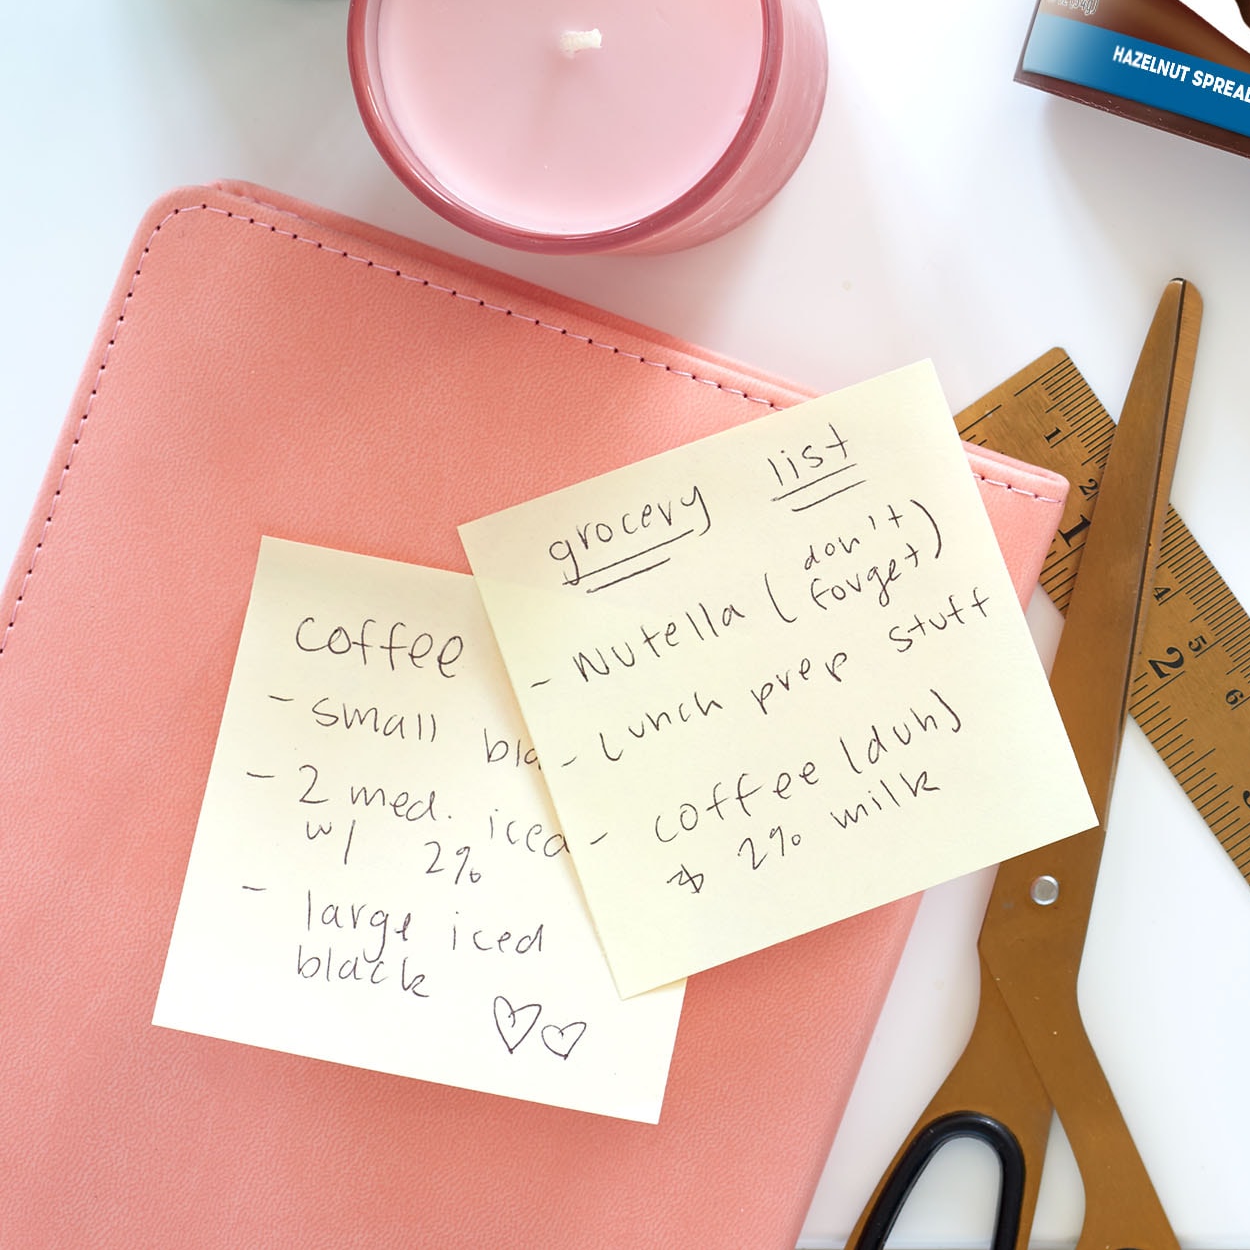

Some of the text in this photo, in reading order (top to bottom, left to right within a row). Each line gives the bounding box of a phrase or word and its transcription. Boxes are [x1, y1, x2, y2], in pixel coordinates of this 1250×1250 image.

[1112, 44, 1191, 84] HAZELNUT
[1044, 427, 1061, 443] 1
[549, 422, 850, 586] grocery list
[1079, 478, 1099, 496] 2
[1058, 514, 1092, 547] 1
[1153, 584, 1172, 603] 4
[750, 651, 849, 715] prep
[888, 586, 991, 653] stuff
[1148, 646, 1185, 679] 2
[1187, 634, 1208, 653] 5
[1225, 688, 1244, 707] 6
[311, 696, 542, 771] small bla
[299, 764, 329, 805] 2
[830, 770, 941, 829] milk
[307, 889, 544, 964] large iced
[297, 944, 430, 998] black
